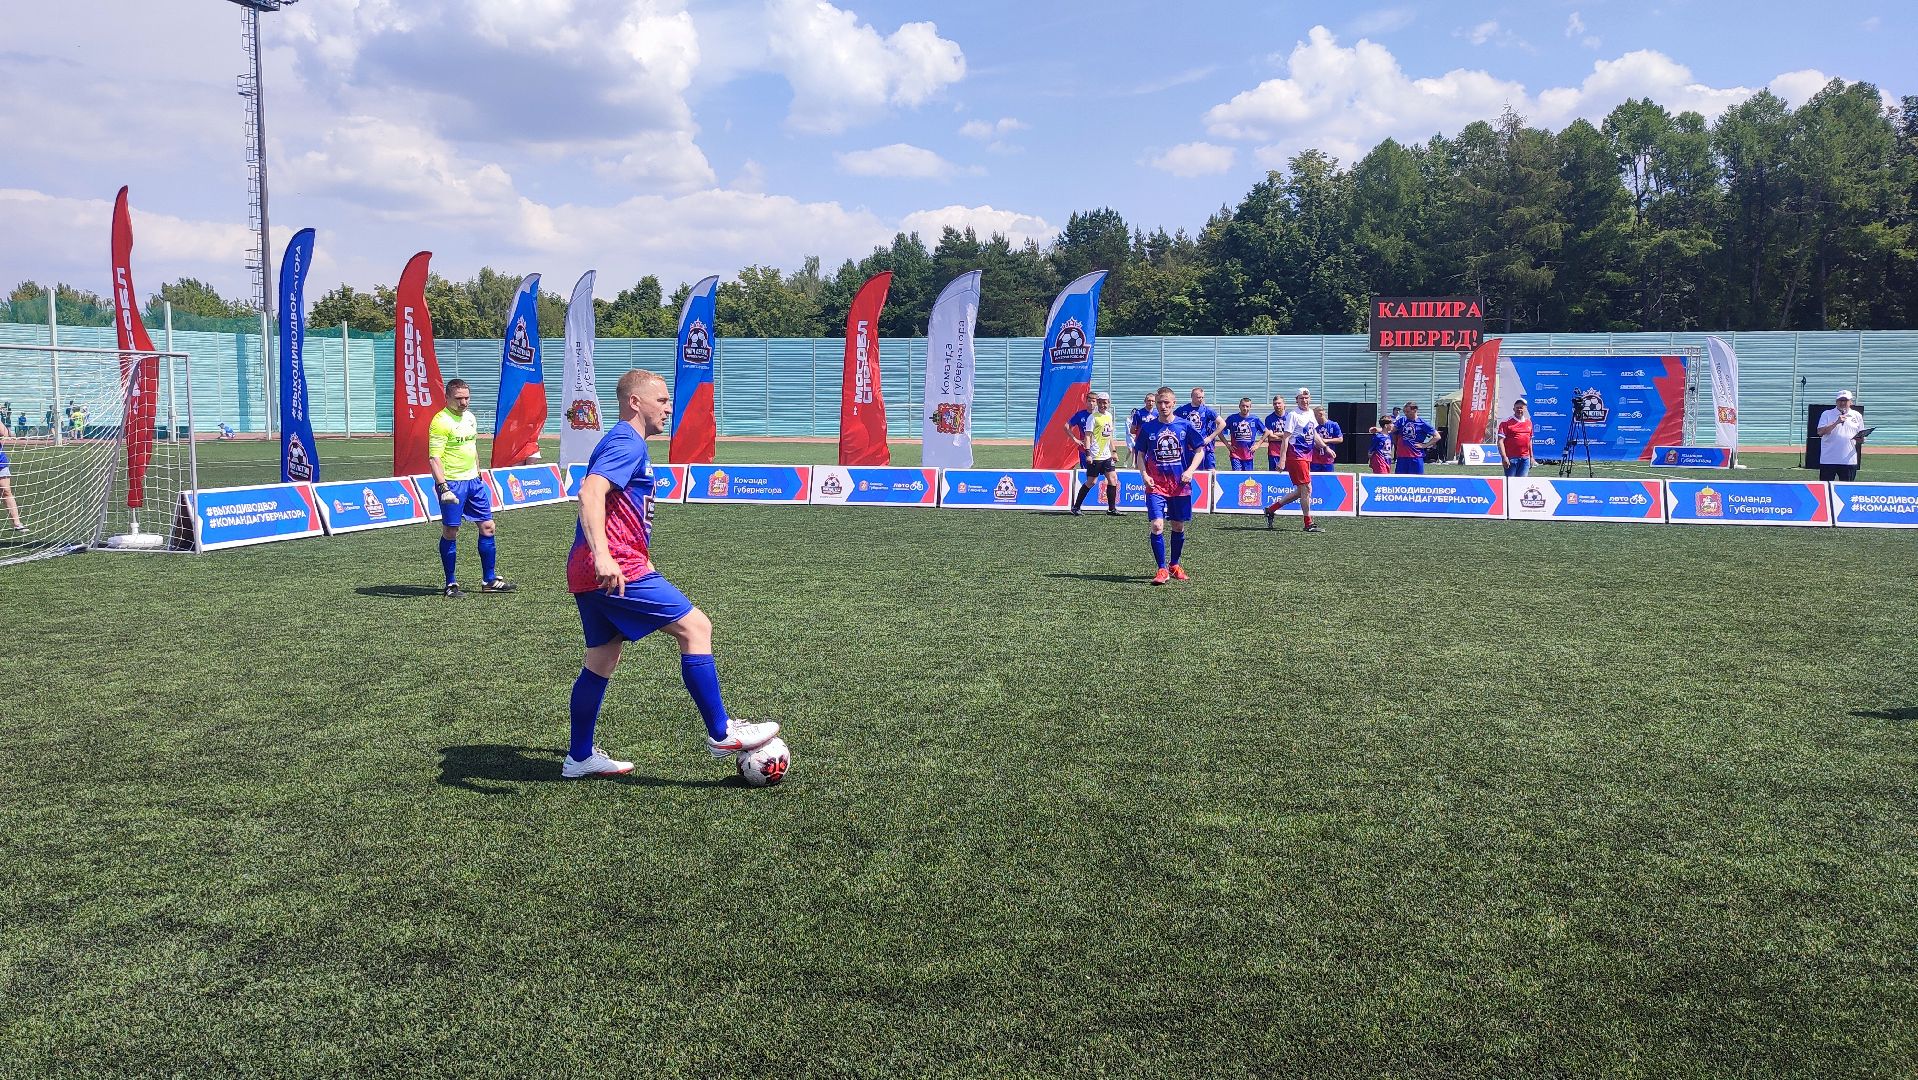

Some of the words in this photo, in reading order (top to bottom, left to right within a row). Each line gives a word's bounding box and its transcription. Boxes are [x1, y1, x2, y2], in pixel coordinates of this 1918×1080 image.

[1378, 301, 1483, 318] КАШИРА
[1379, 330, 1478, 350] ВПЕРЕД!
[404, 306, 418, 405] МОСОБЛ
[854, 320, 869, 404] МОСОБЛ
[416, 329, 432, 407] СПОРТ
[940, 343, 954, 395] Команда
[734, 477, 768, 486] Команда
[733, 485, 783, 496] Губернатора
[1374, 493, 1490, 504] #КОМАНДАГУБЕРНАТОРА
[1728, 494, 1773, 505] Команда
[205, 501, 278, 517] #ВЫХОДИВОДВОР
[1728, 504, 1793, 516] Губернатора
[1851, 503, 1918, 514] #КОМАНДАГ
[209, 510, 307, 529] #КОМАНДАГУБЕРНАТОРА
